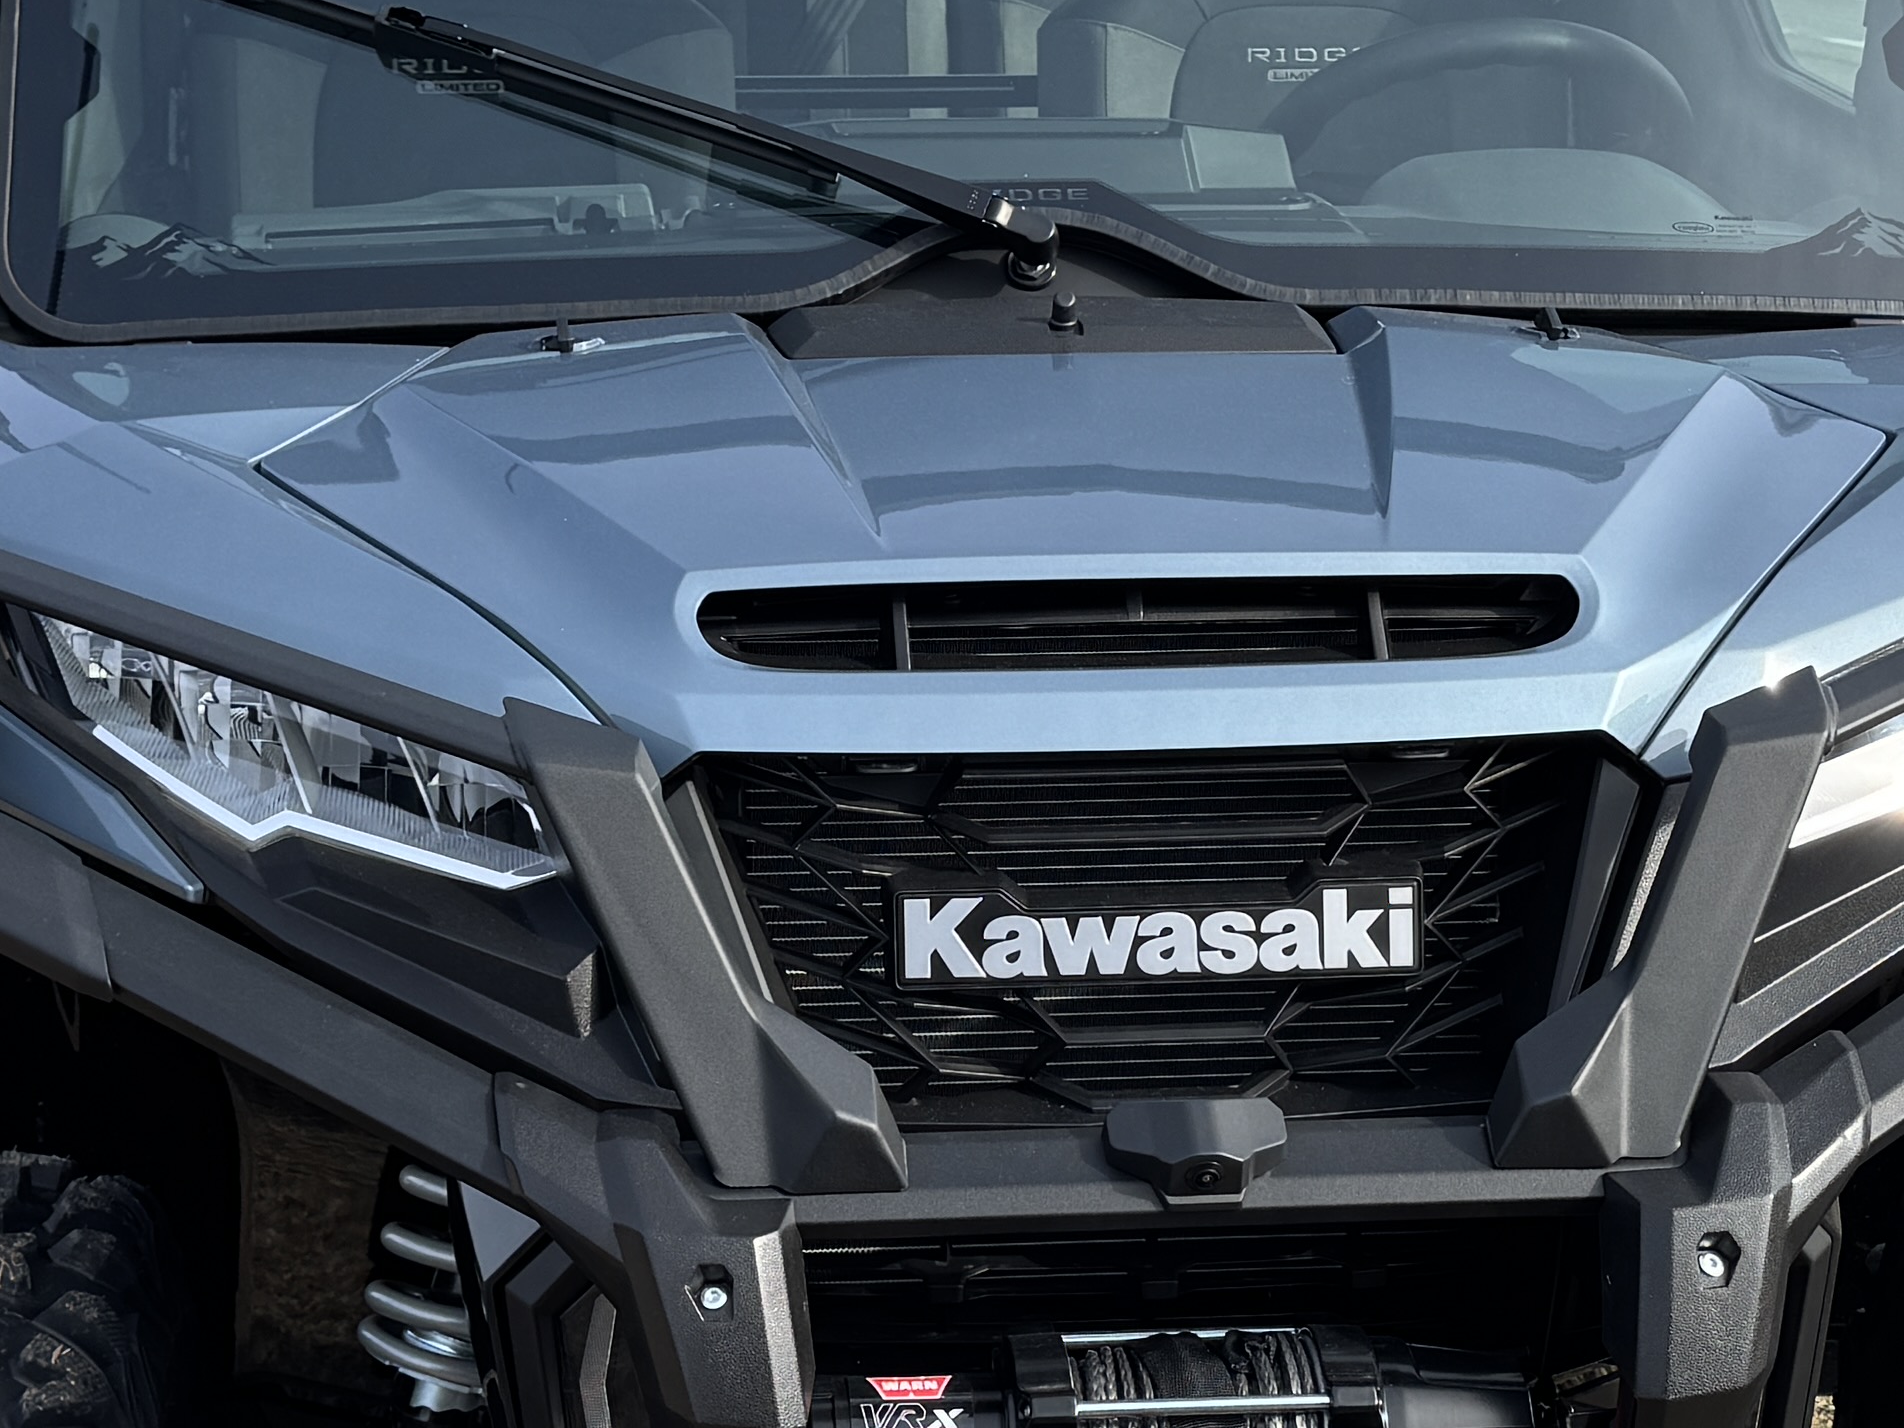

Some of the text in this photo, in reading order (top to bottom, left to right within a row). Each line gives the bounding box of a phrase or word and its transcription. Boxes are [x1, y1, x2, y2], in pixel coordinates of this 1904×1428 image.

[1247, 46, 1360, 63] RIDG
[903, 886, 1416, 980] Kawasaki
[881, 1379, 939, 1391] WARN
